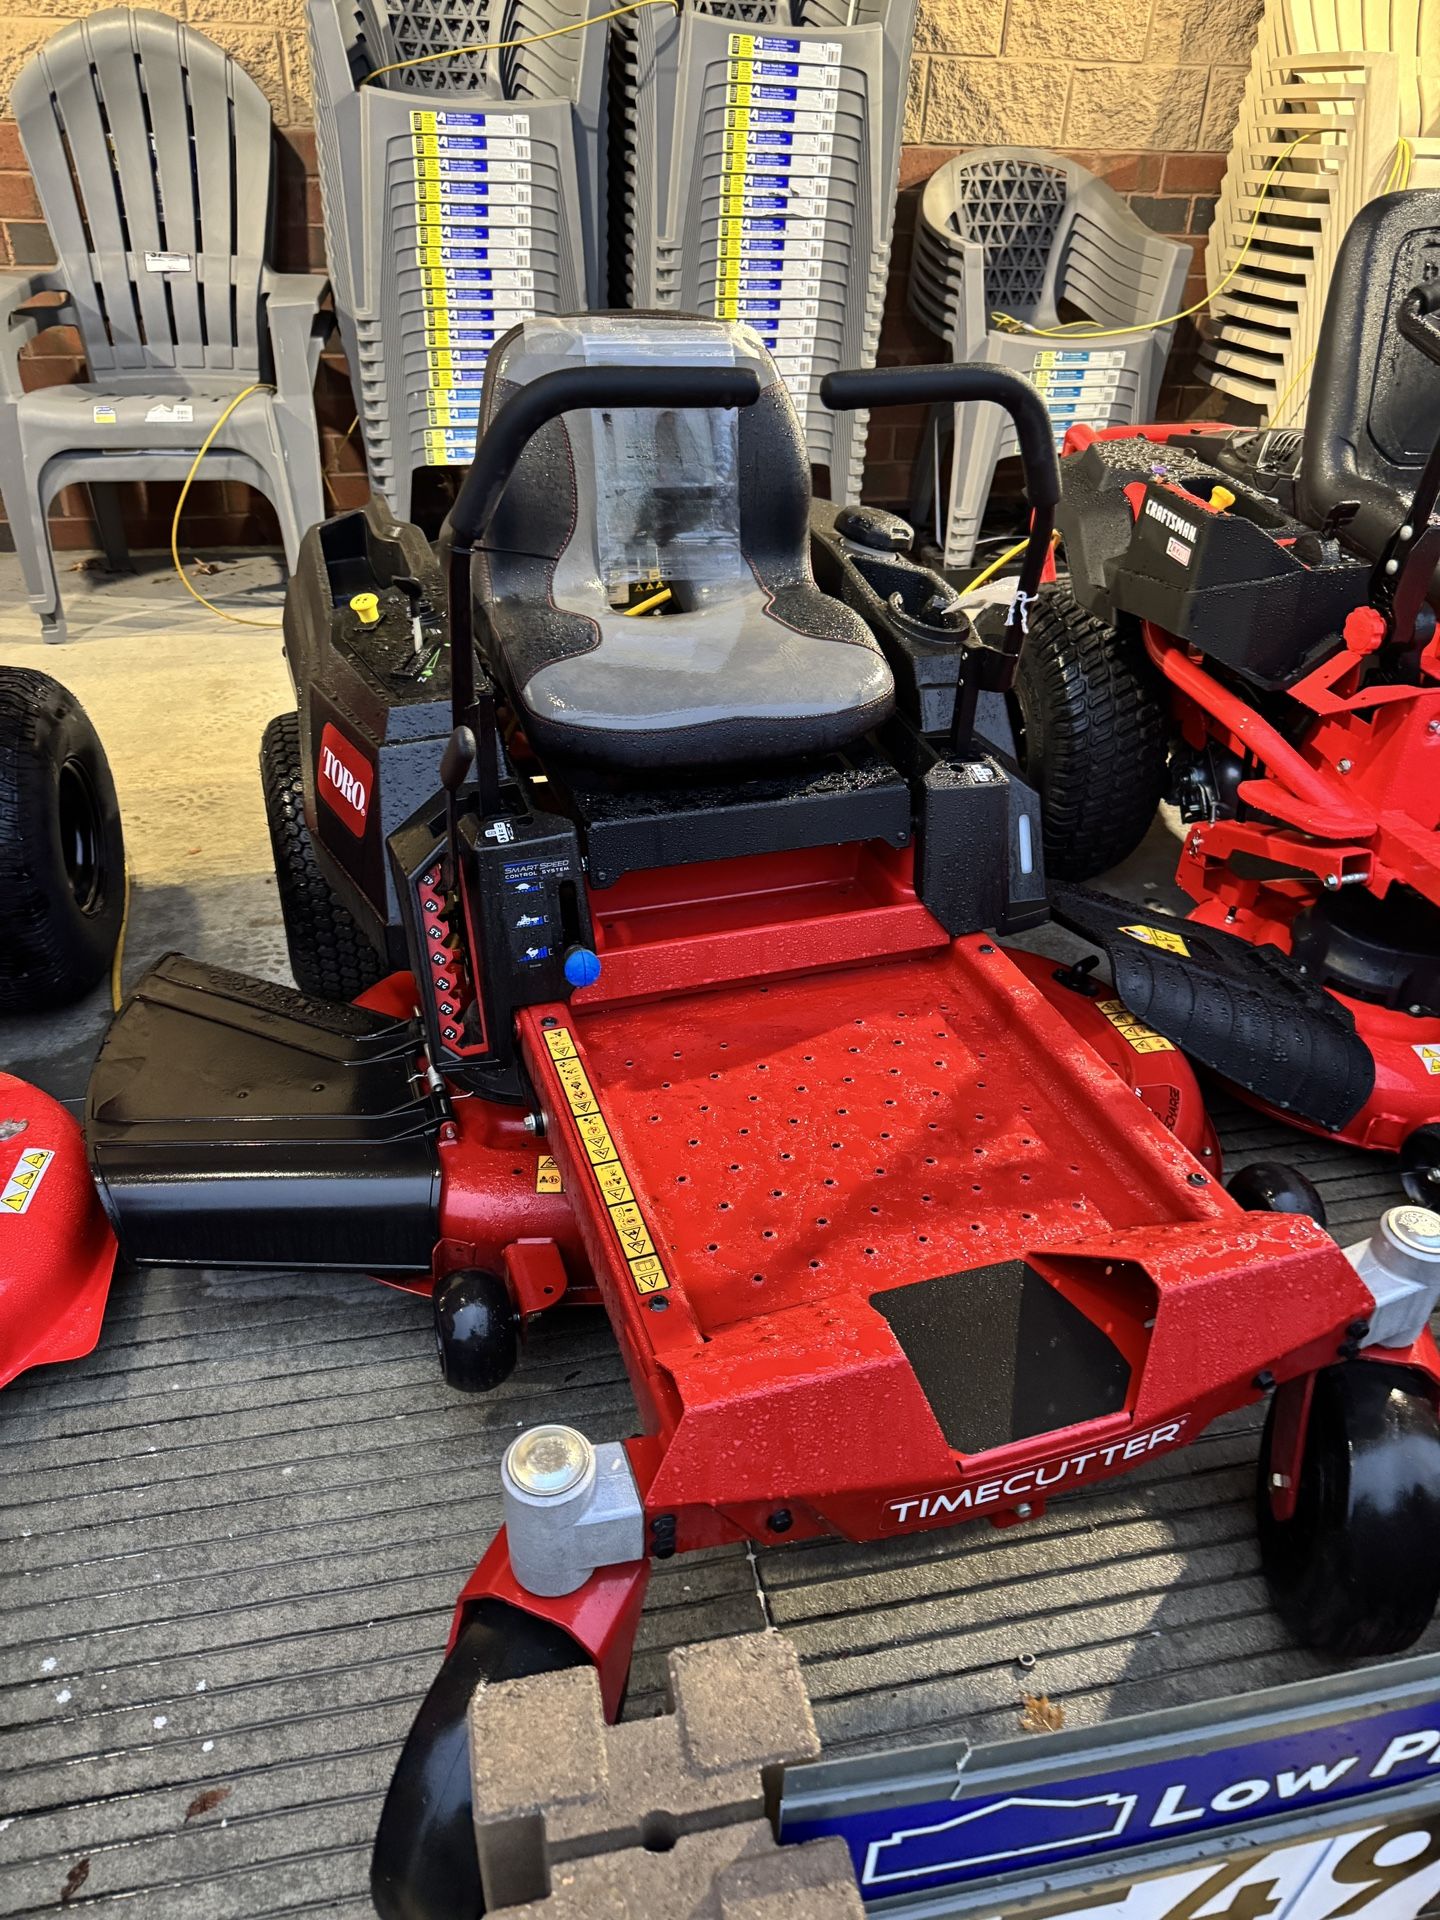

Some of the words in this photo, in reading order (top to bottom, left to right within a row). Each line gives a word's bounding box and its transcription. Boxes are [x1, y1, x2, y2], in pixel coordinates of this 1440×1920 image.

[1145, 499, 1197, 544] CRAFTSMAN
[322, 746, 366, 812] TORO
[505, 872, 538, 880] CONTROL
[541, 866, 570, 874] SYSTEM
[422, 875, 435, 886] 4.5
[425, 901, 437, 911] 4.0
[429, 928, 442, 938] 3.5
[433, 953, 446, 964] 3.0
[437, 979, 449, 989] 2.5
[440, 1004, 453, 1014] 2.0
[444, 1028, 457, 1039] 1.5
[889, 1425, 1178, 1522] TIMECUTTER
[1368, 1729, 1440, 1778] P
